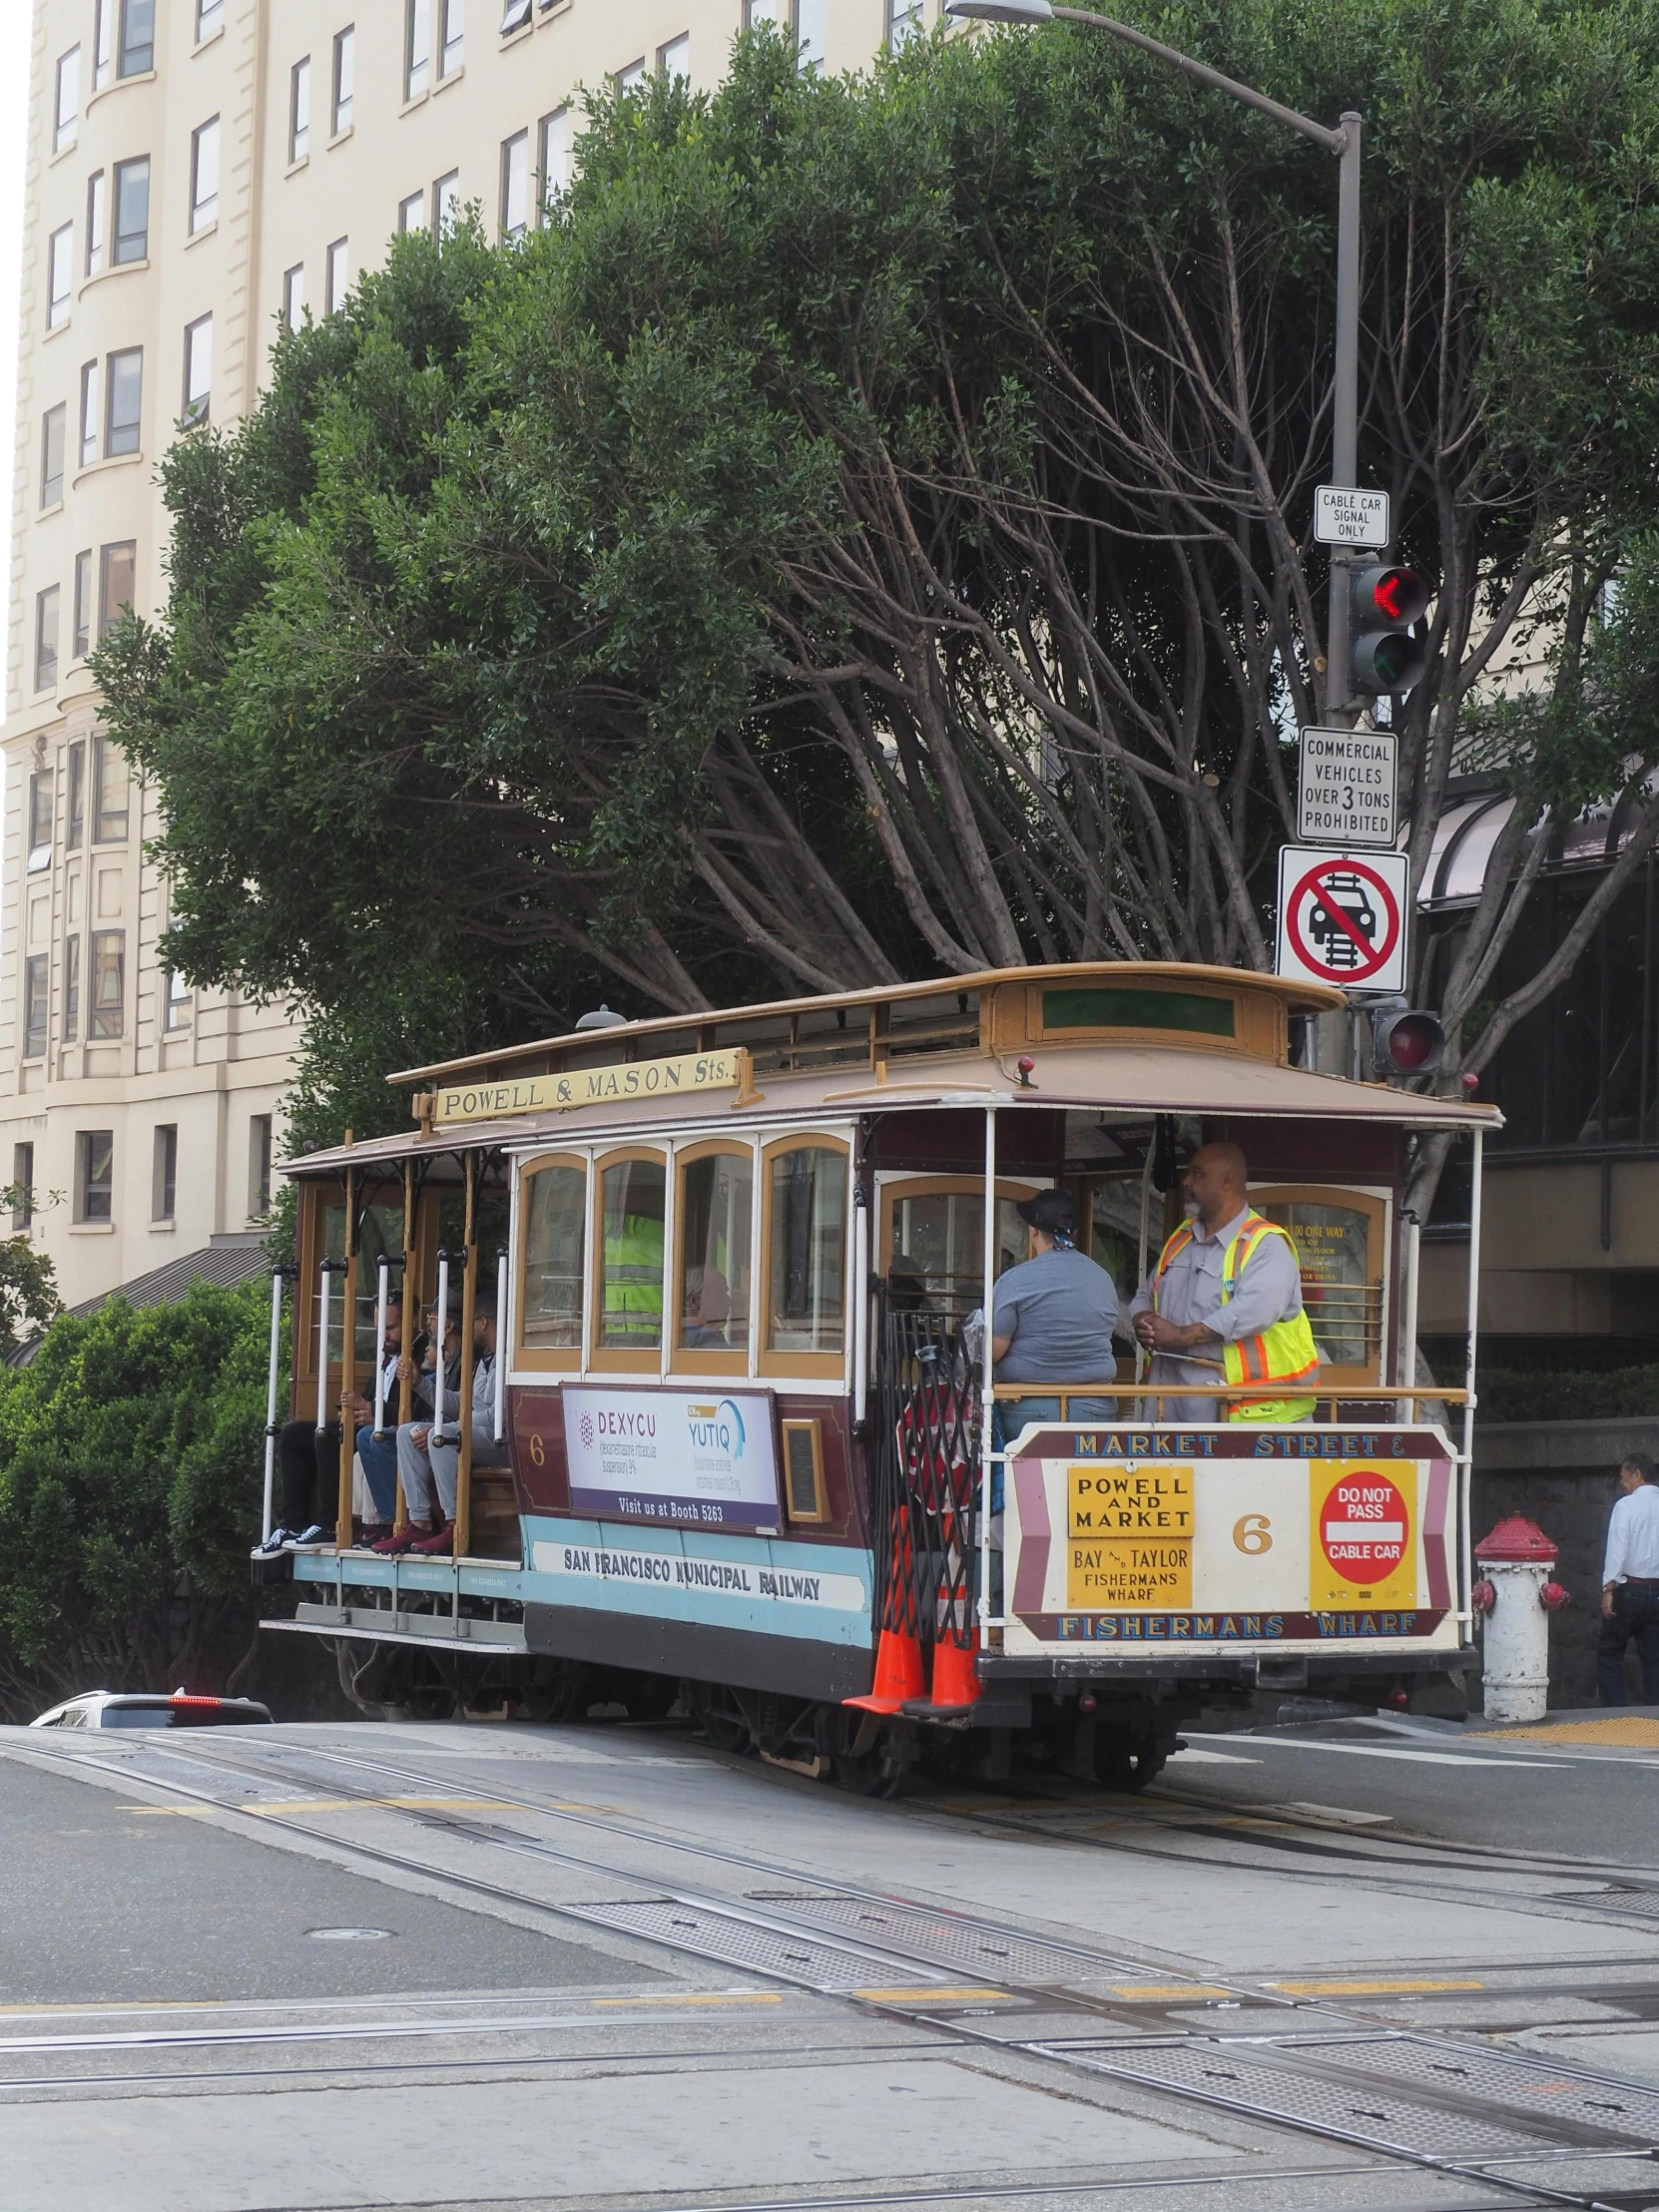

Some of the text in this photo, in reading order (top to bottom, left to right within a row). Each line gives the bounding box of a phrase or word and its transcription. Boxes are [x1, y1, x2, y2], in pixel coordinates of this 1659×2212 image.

[1324, 494, 1382, 511] CABLE CAR
[1334, 509, 1370, 524] SIGNAL
[1339, 523, 1366, 537] ONLY
[1308, 740, 1389, 761] COMMERCIAL
[1316, 764, 1382, 784] VEHICLES
[1306, 786, 1389, 811] OVER 3 TONS
[1306, 812, 1388, 832] PROHIBITED
[444, 1084, 544, 1116] POWELL
[556, 1079, 573, 1103] &
[587, 1064, 682, 1098] MASON
[1306, 1226, 1324, 1238] ONE
[1326, 1227, 1345, 1238] WAY
[598, 1410, 656, 1437] DEXYCU
[688, 1422, 730, 1452] YUTIQ
[1074, 1433, 1219, 1457] MARKET
[1254, 1432, 1380, 1457] STREET
[530, 1433, 545, 1466] 6
[1078, 1478, 1188, 1495] POWELL
[1338, 1487, 1393, 1503] DO NOT
[619, 1496, 724, 1522] Visit us at Booth 5263
[1108, 1496, 1161, 1508] AND
[1347, 1503, 1384, 1519] PASS
[1076, 1511, 1190, 1527] MARKET
[1233, 1513, 1274, 1555] 6
[1074, 1549, 1188, 1568] BAY AND TAYLOR
[1329, 1544, 1400, 1559] CABLE CAR
[564, 1548, 591, 1572] SAN
[759, 1571, 821, 1601] RAILWAY
[1084, 1573, 1178, 1586] FISHERMANS
[1107, 1588, 1156, 1601] WHARF
[1057, 1613, 1416, 1640] FISHERMANS WHARF
